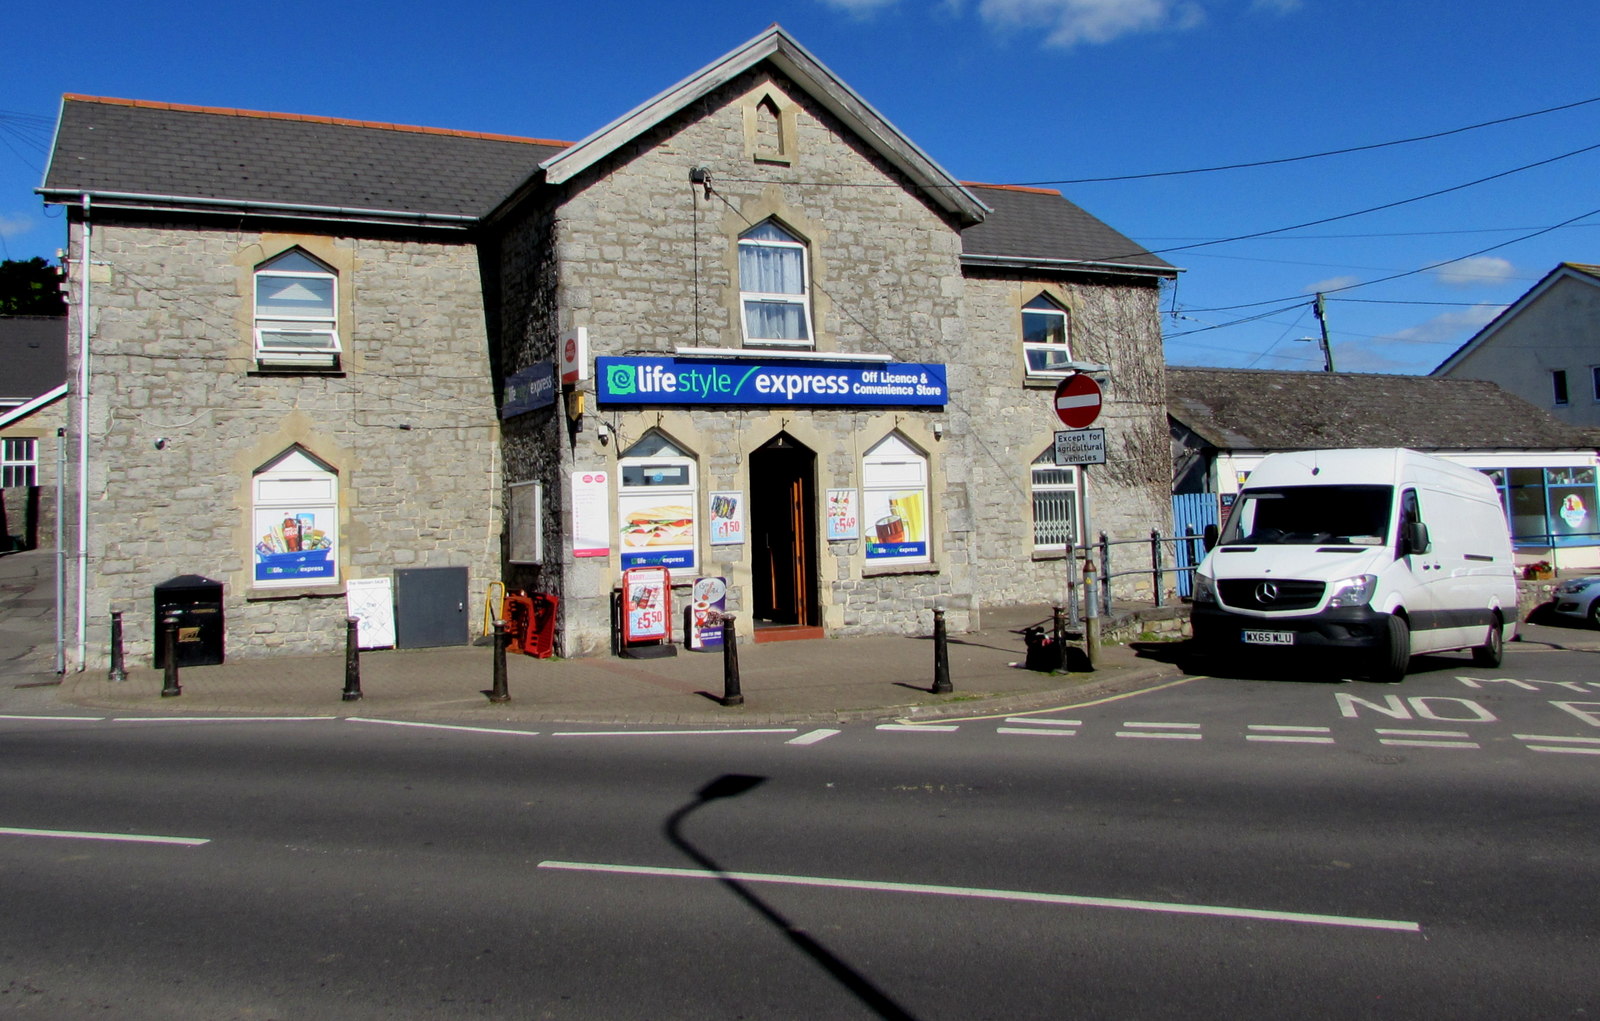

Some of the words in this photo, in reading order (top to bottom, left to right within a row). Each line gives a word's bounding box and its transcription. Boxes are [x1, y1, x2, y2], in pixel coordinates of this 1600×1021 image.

[637, 365, 731, 398] lifestyle
[755, 374, 849, 399] express
[861, 371, 878, 383] Off
[880, 372, 918, 384] Licence
[919, 374, 928, 384] &
[853, 384, 914, 395] Convenience
[916, 385, 942, 396] Store
[1058, 431, 1085, 443] Except
[1089, 432, 1101, 441] for
[1057, 442, 1103, 454] agricultural
[1064, 454, 1097, 463] vehicles
[1334, 693, 1498, 722] NO
